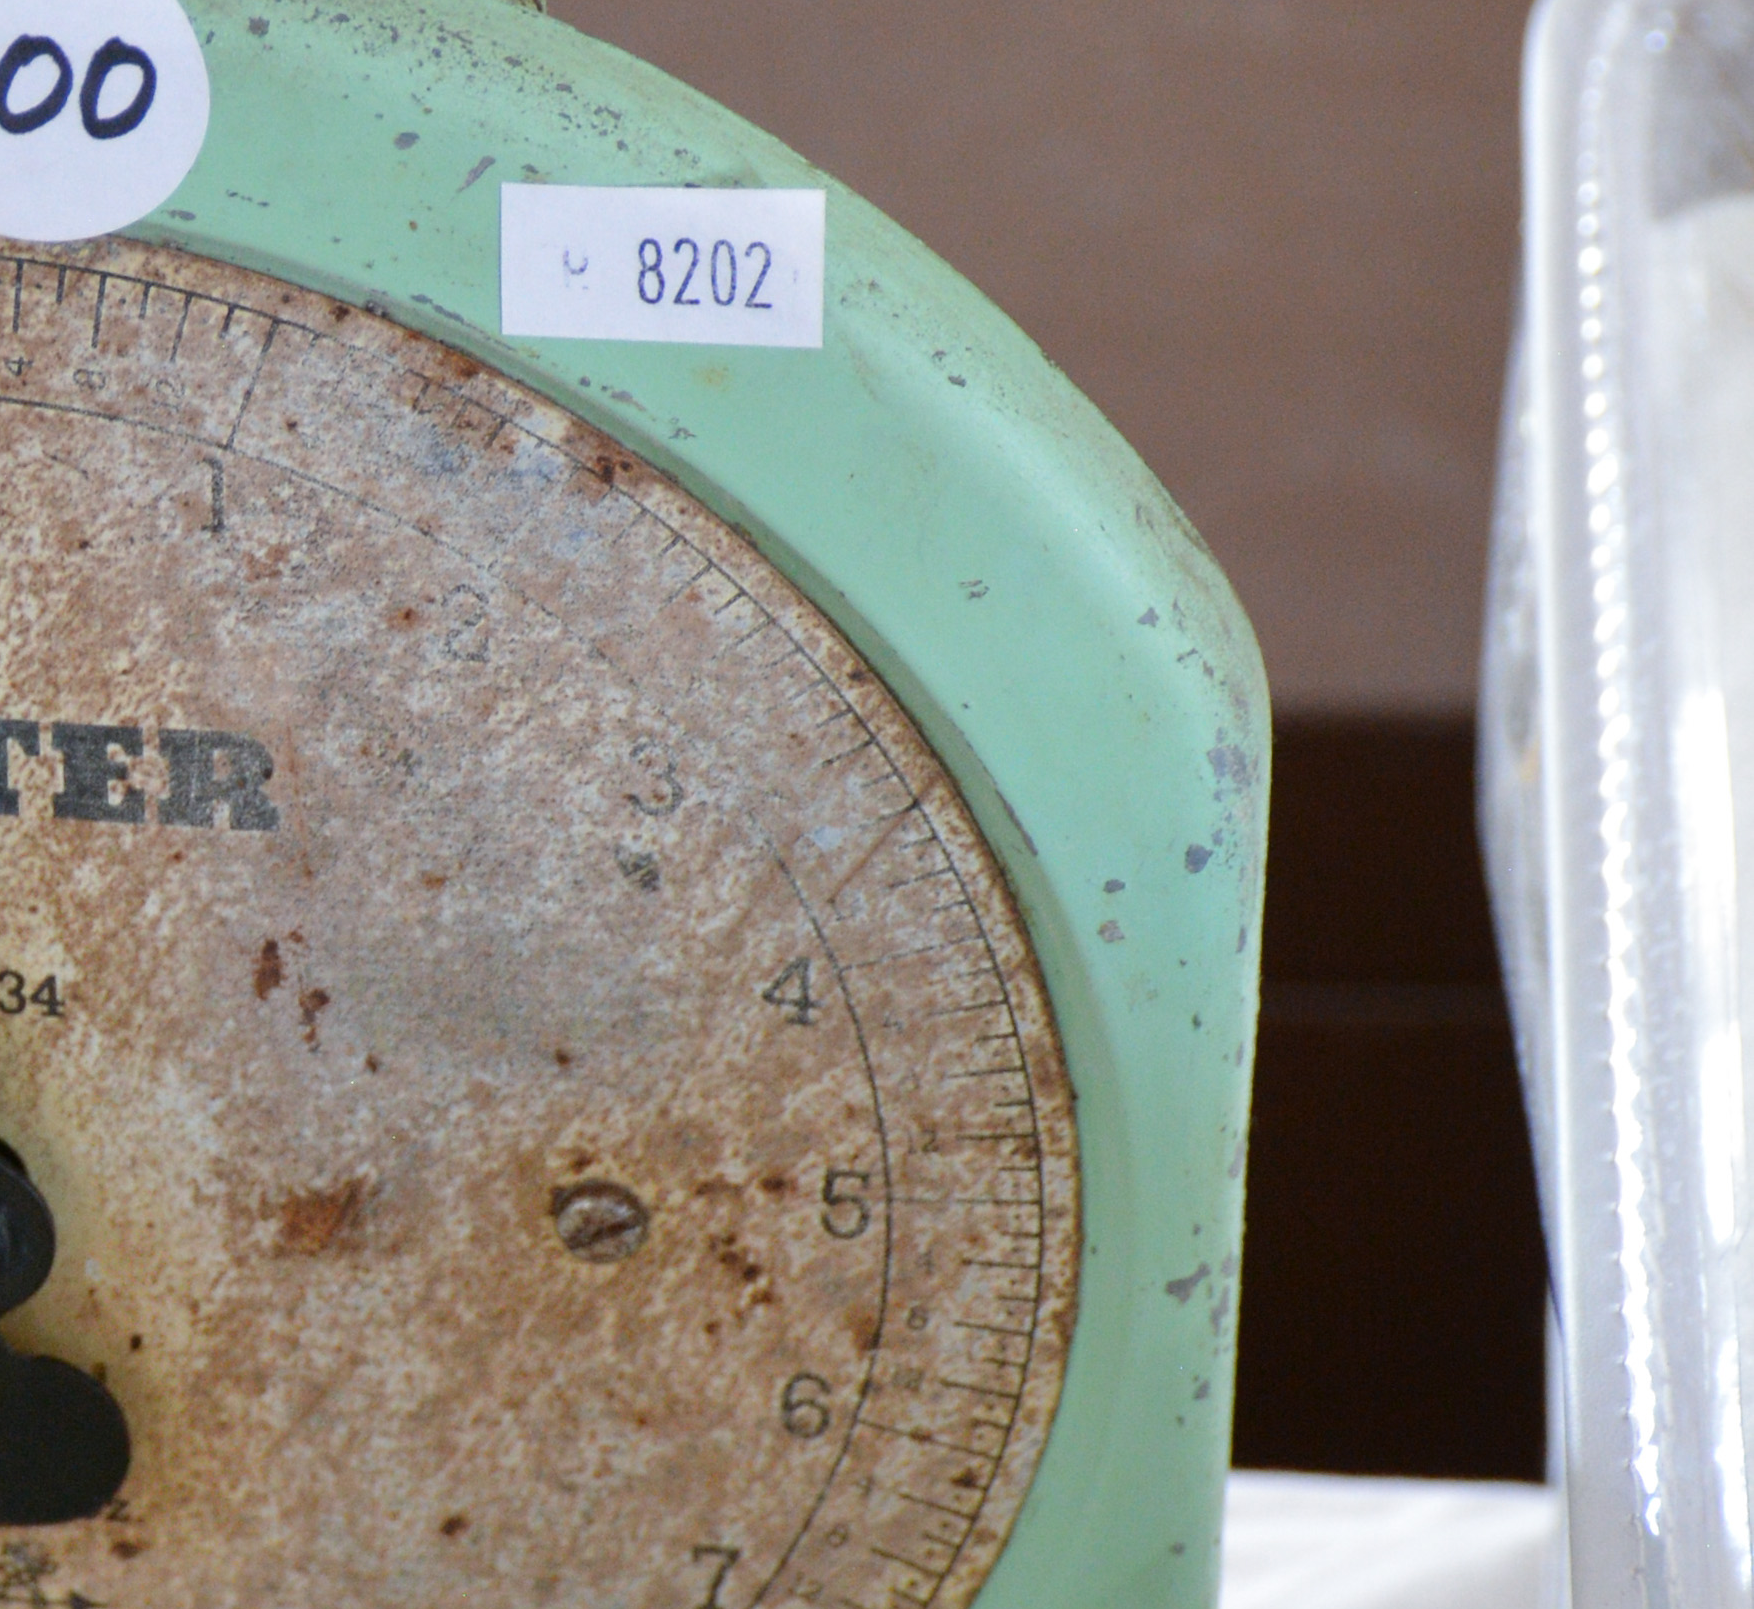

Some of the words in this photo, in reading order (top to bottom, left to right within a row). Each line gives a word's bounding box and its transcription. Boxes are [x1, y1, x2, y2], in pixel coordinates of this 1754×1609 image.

[637, 236, 774, 310] 8202
[3, 356, 34, 377] 4
[72, 367, 106, 392] 8
[201, 454, 226, 535] 1
[627, 740, 685, 818] 3
[760, 955, 824, 1027] 4
[820, 1168, 871, 1240] 5
[780, 1371, 833, 1440] 6
